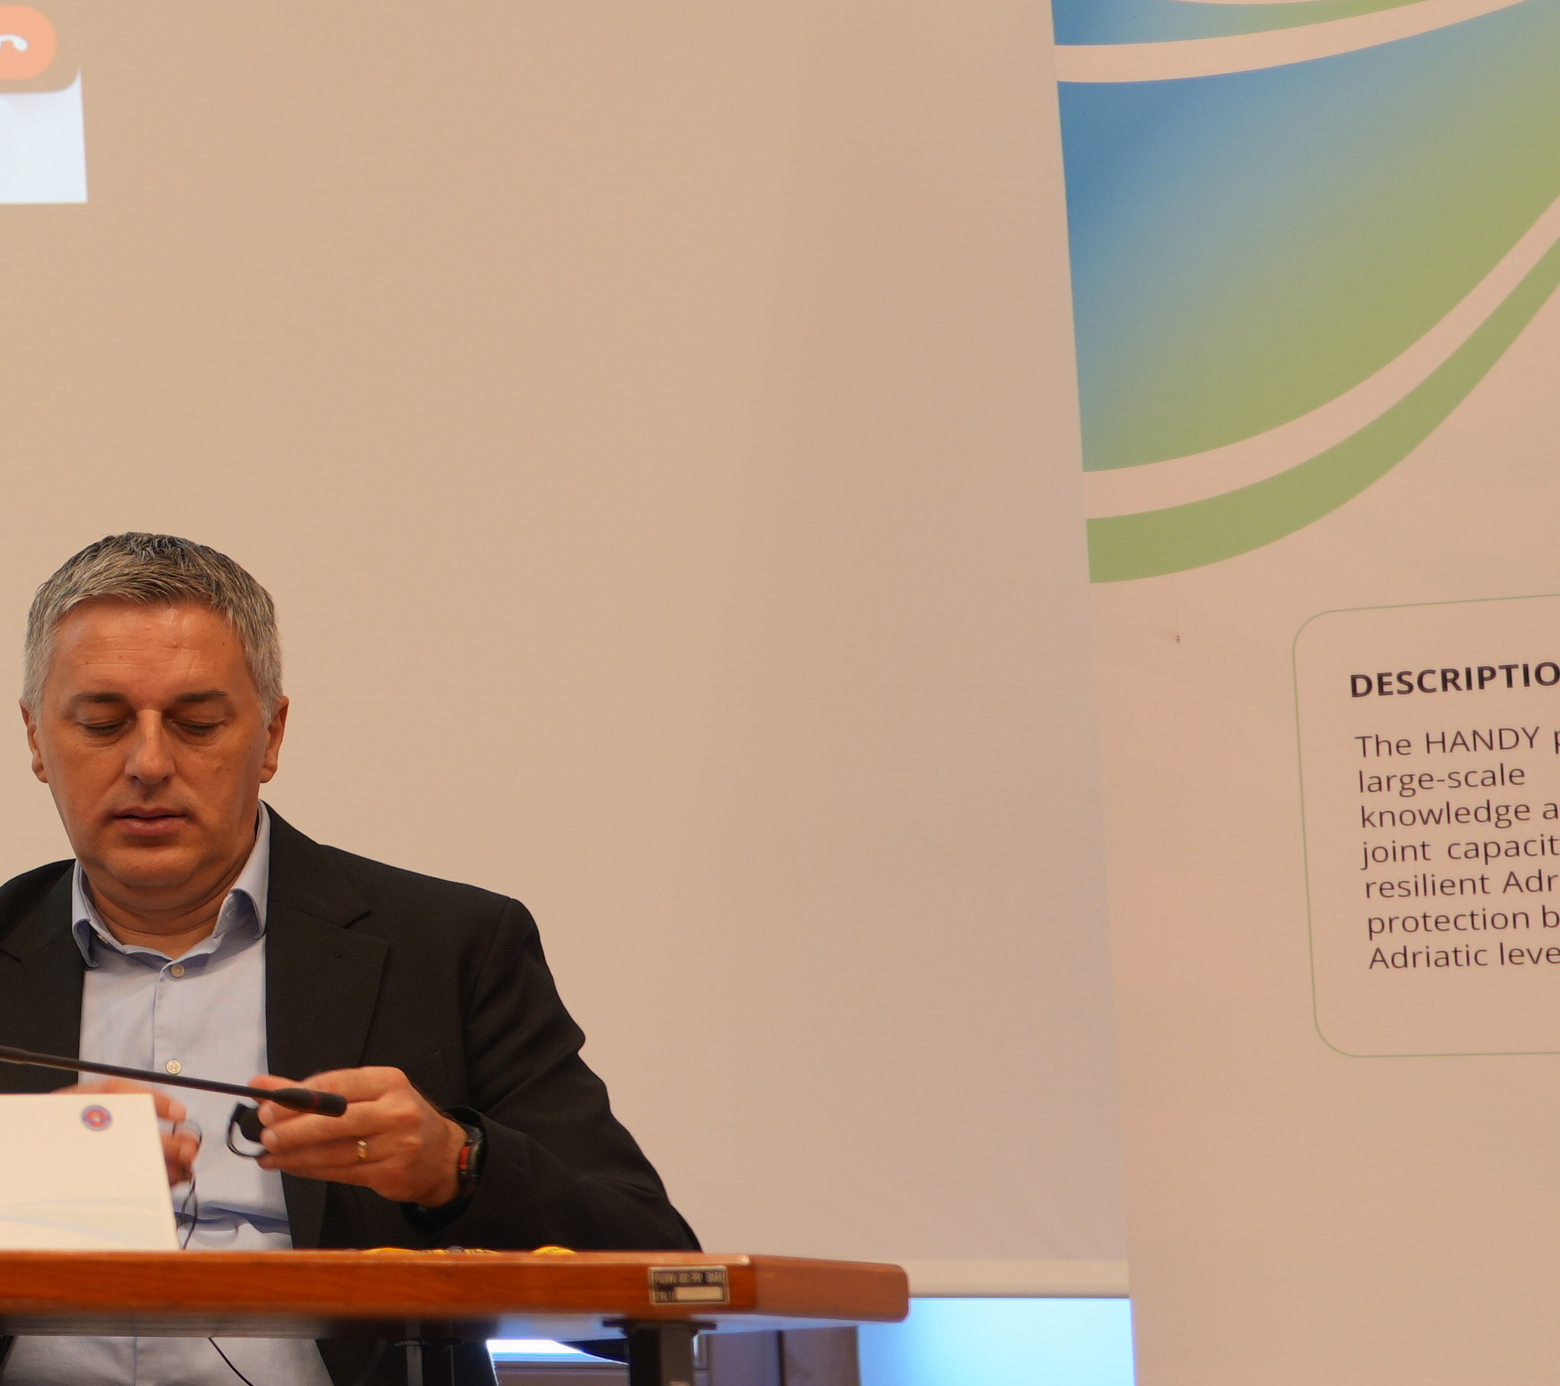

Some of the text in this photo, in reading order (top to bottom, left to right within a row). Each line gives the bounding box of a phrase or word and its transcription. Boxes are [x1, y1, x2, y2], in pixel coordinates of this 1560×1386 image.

[1355, 726, 1540, 757] The HANDY
[1359, 763, 1526, 797] large-scale
[1361, 799, 1531, 829] knowledge
[1360, 839, 1432, 871] joint
[1365, 873, 1491, 898] resilient
[1368, 908, 1530, 941] protection
[1369, 944, 1488, 969] Adriatic
